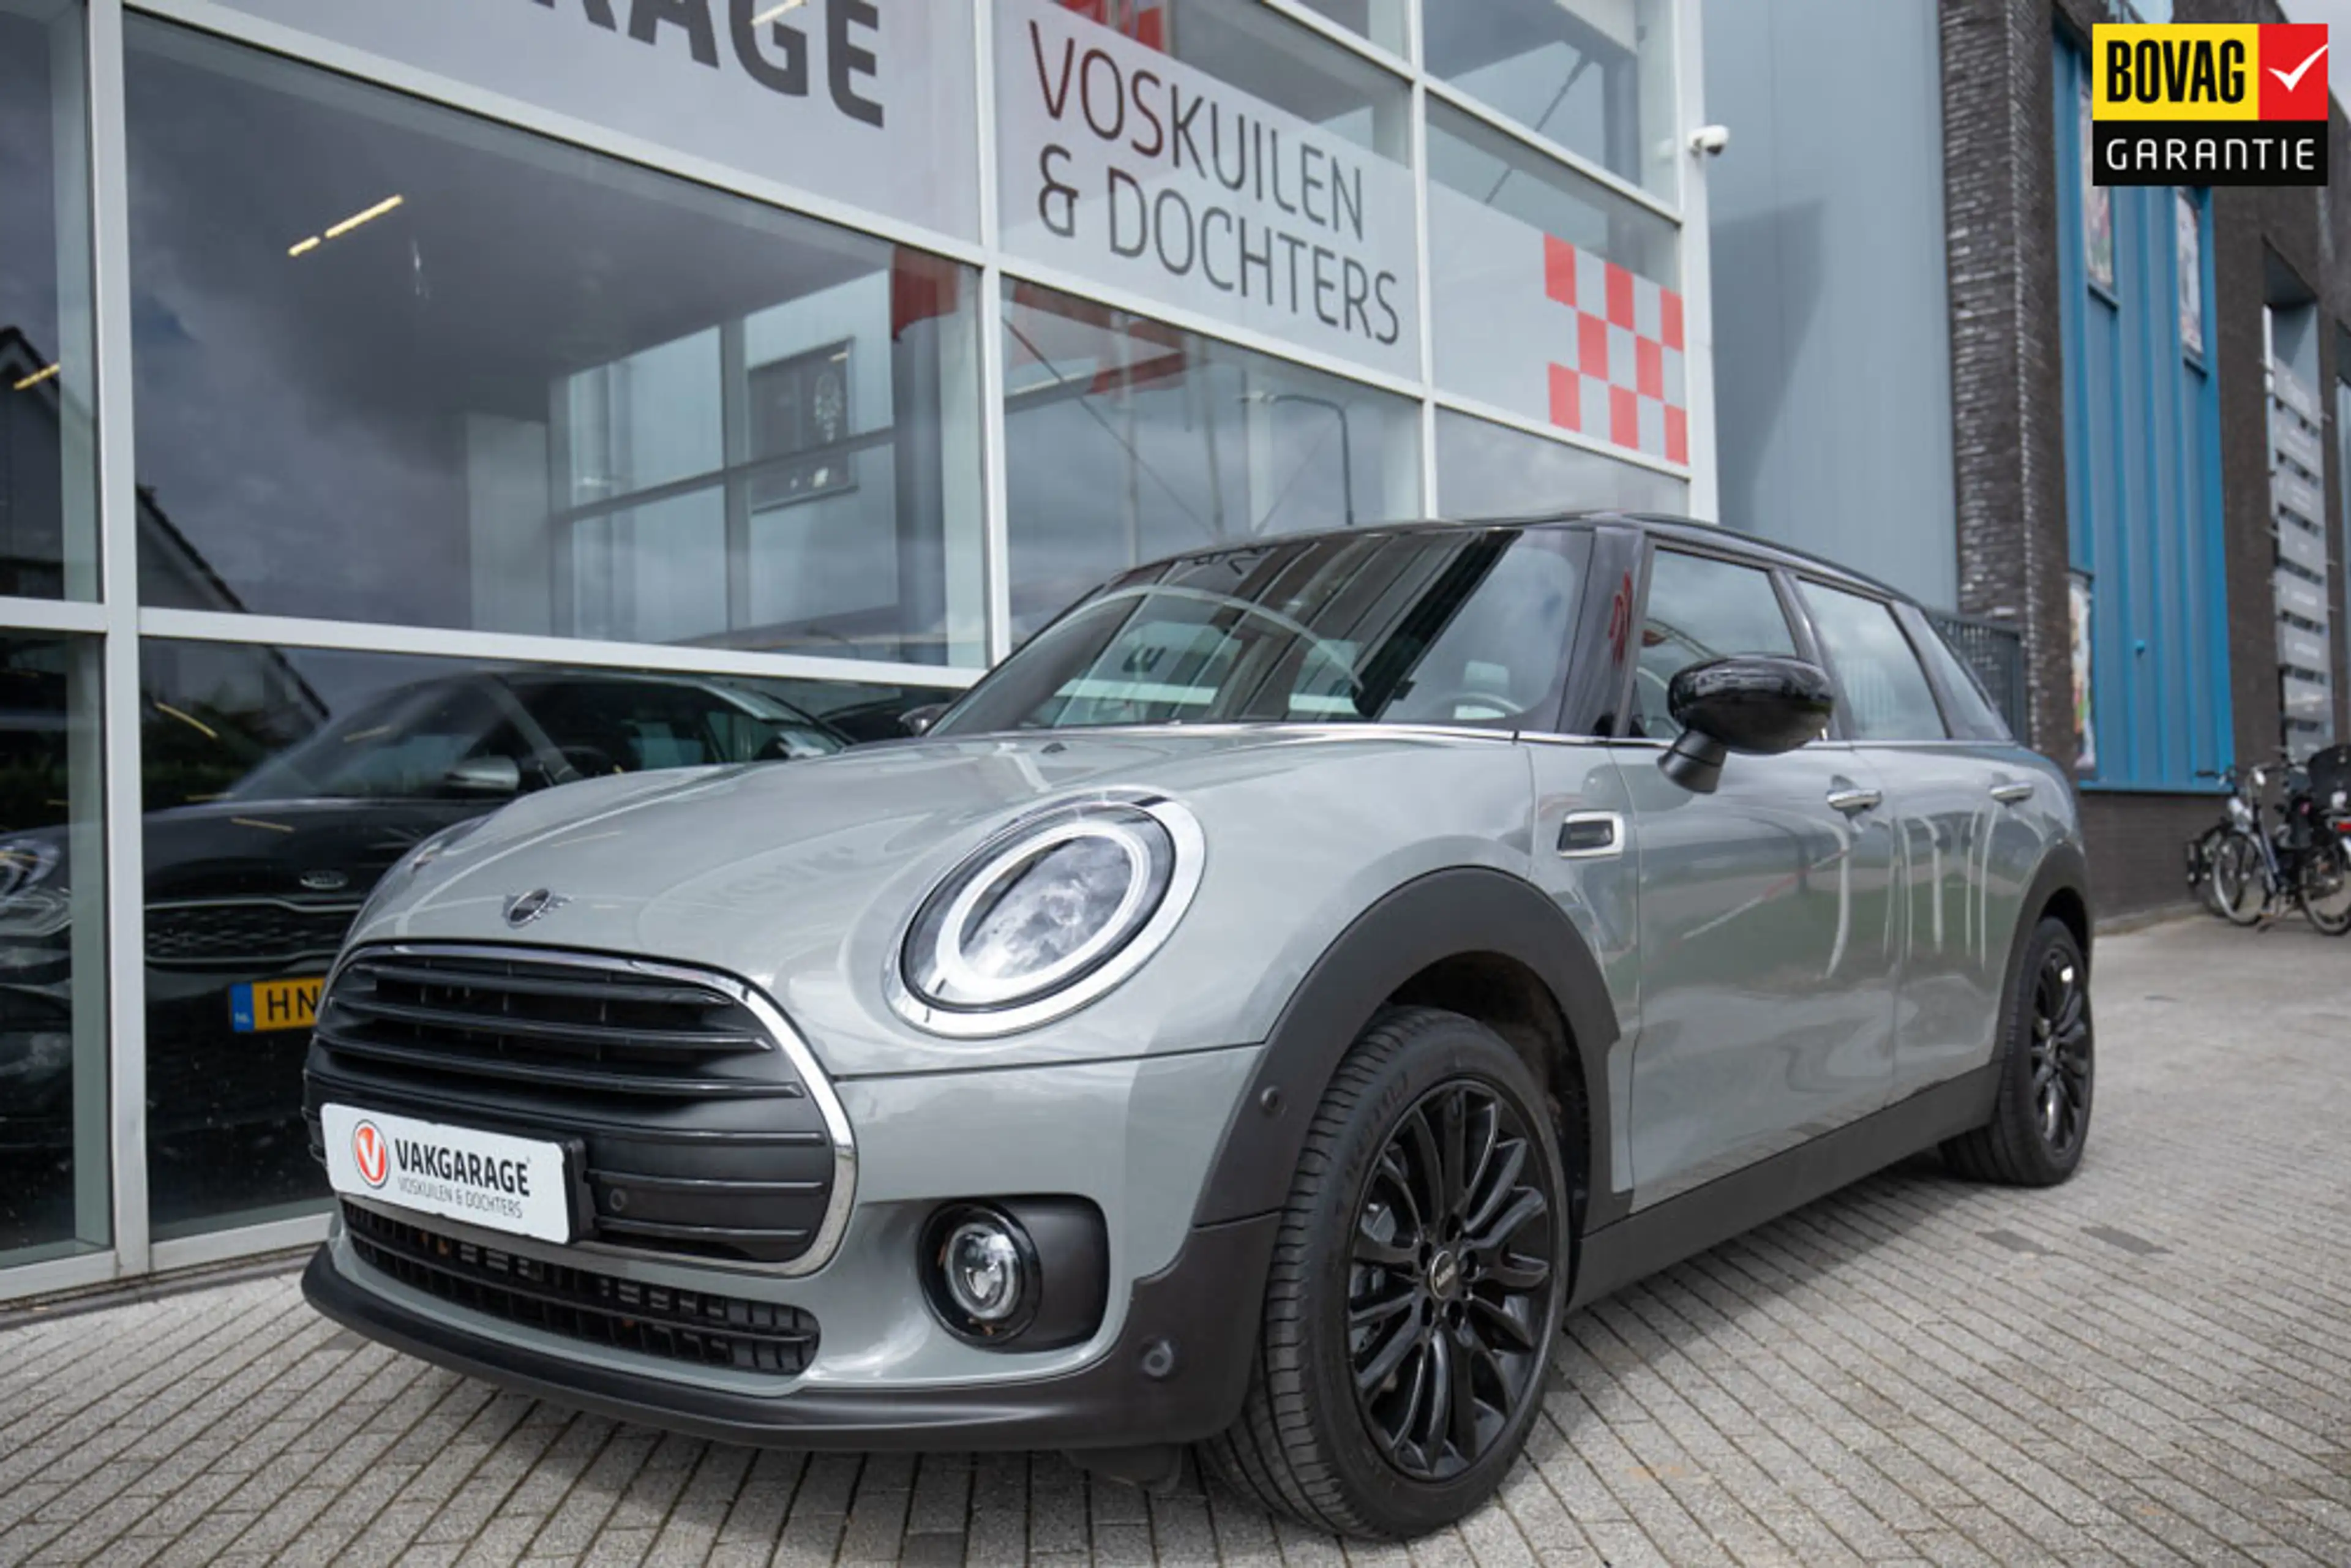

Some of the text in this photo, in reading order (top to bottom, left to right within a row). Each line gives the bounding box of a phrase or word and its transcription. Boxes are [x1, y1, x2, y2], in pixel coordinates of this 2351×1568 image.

[1029, 20, 1362, 242] VOSKUILEN
[1038, 144, 1400, 345] & DOCHTERS
[395, 1138, 530, 1197] VAKGARAGE
